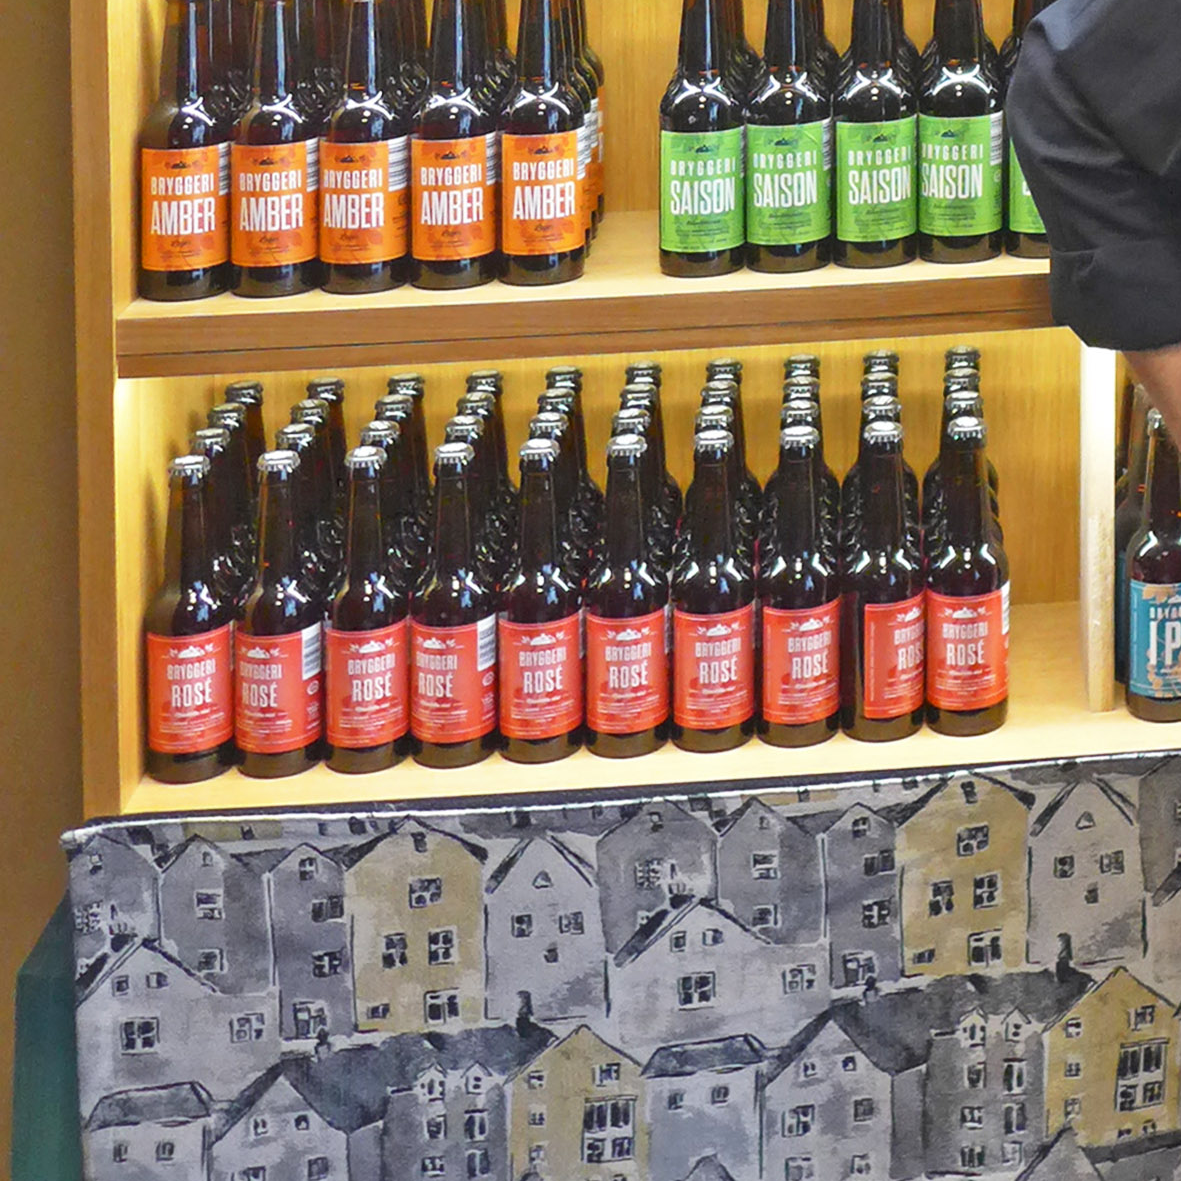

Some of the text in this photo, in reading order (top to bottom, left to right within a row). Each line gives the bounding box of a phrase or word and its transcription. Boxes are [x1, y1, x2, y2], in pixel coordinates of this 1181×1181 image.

[513, 158, 574, 181] BRYGGERI
[670, 158, 735, 176] BRYGGERI
[753, 150, 817, 169] BRYGGERI
[848, 145, 911, 166] BRYGGERI
[151, 173, 214, 195] BRYGGERI
[239, 169, 302, 192] BRYGGERI
[323, 168, 383, 189] BRYGGERI
[421, 163, 482, 186] BRYGGERI
[848, 165, 911, 204] SAISON
[922, 163, 982, 199] SAISON
[513, 181, 575, 219] AMBER
[670, 177, 735, 215] SAISON
[753, 170, 817, 208] SAISON
[151, 197, 216, 235] AMBER
[239, 193, 303, 232] AMBER
[323, 192, 384, 229] AMBER
[421, 187, 483, 225] AMBER
[792, 650, 828, 680] ROSÉ
[897, 643, 924, 670] ROS
[946, 640, 984, 666] ROSÉ
[523, 666, 563, 694] ROSÉ
[609, 661, 648, 689] ROSÉ
[700, 656, 738, 684] ROSÉ
[172, 679, 212, 707] ROSÉ
[242, 682, 278, 708] ROSÉ
[352, 673, 392, 702] ROSÉ
[418, 672, 453, 698] ROSÉ
